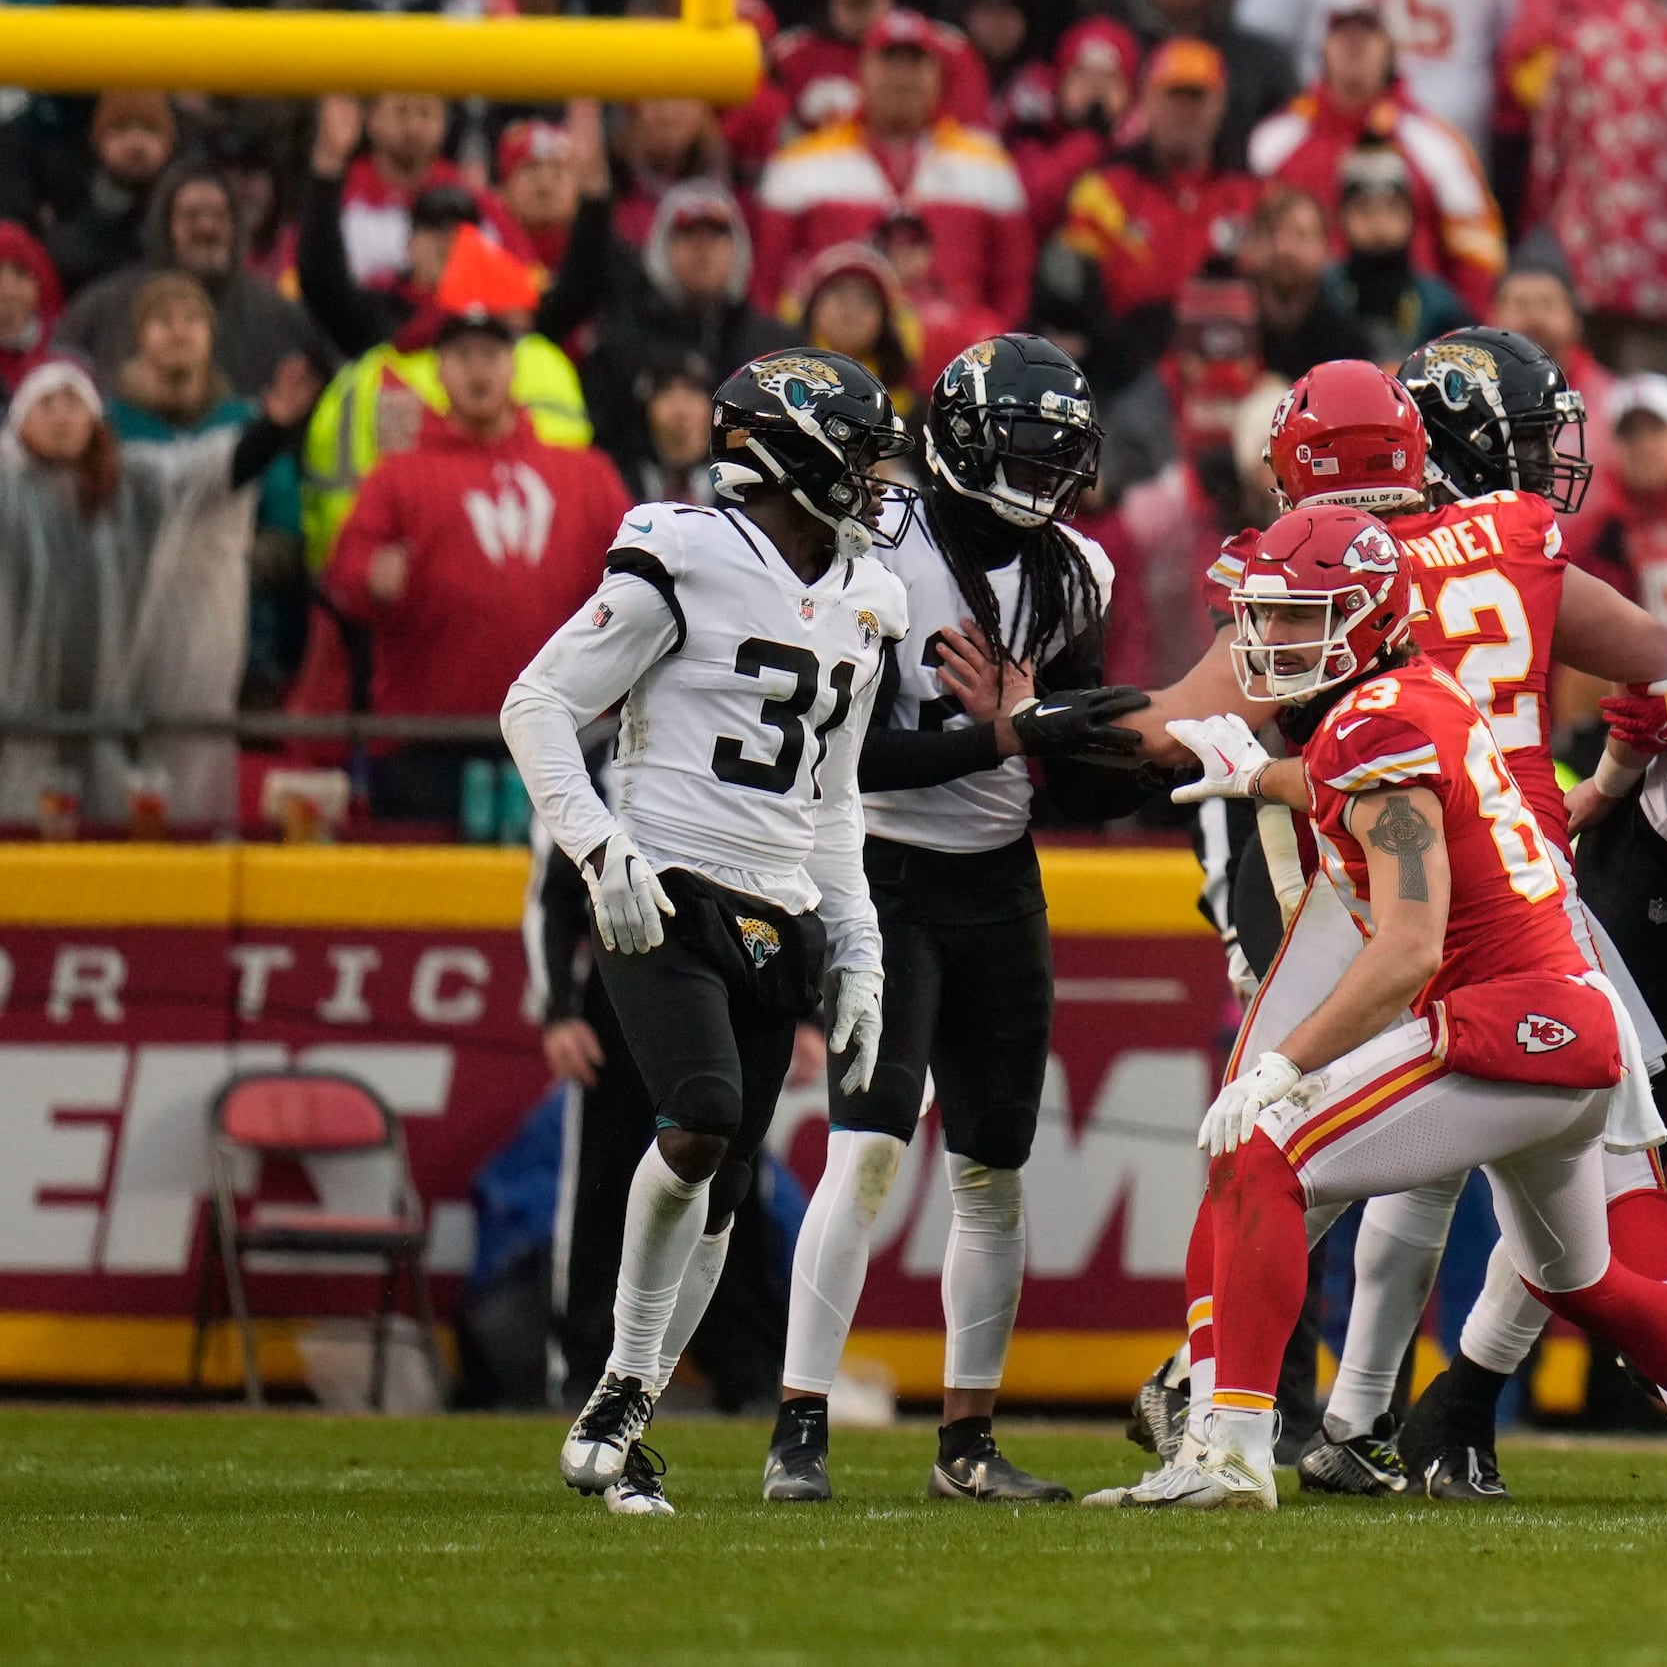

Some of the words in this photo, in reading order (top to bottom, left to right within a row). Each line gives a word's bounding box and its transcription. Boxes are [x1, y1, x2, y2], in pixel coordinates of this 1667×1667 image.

[1327, 495, 1358, 507] TAKES
[1360, 495, 1377, 504] ALL
[1379, 494, 1391, 502] OF
[1392, 493, 1404, 501] US
[1400, 514, 1504, 569] HREY
[1410, 572, 1542, 754] 2
[710, 638, 856, 802] 31
[1218, 1468, 1241, 1486] ALPHA
